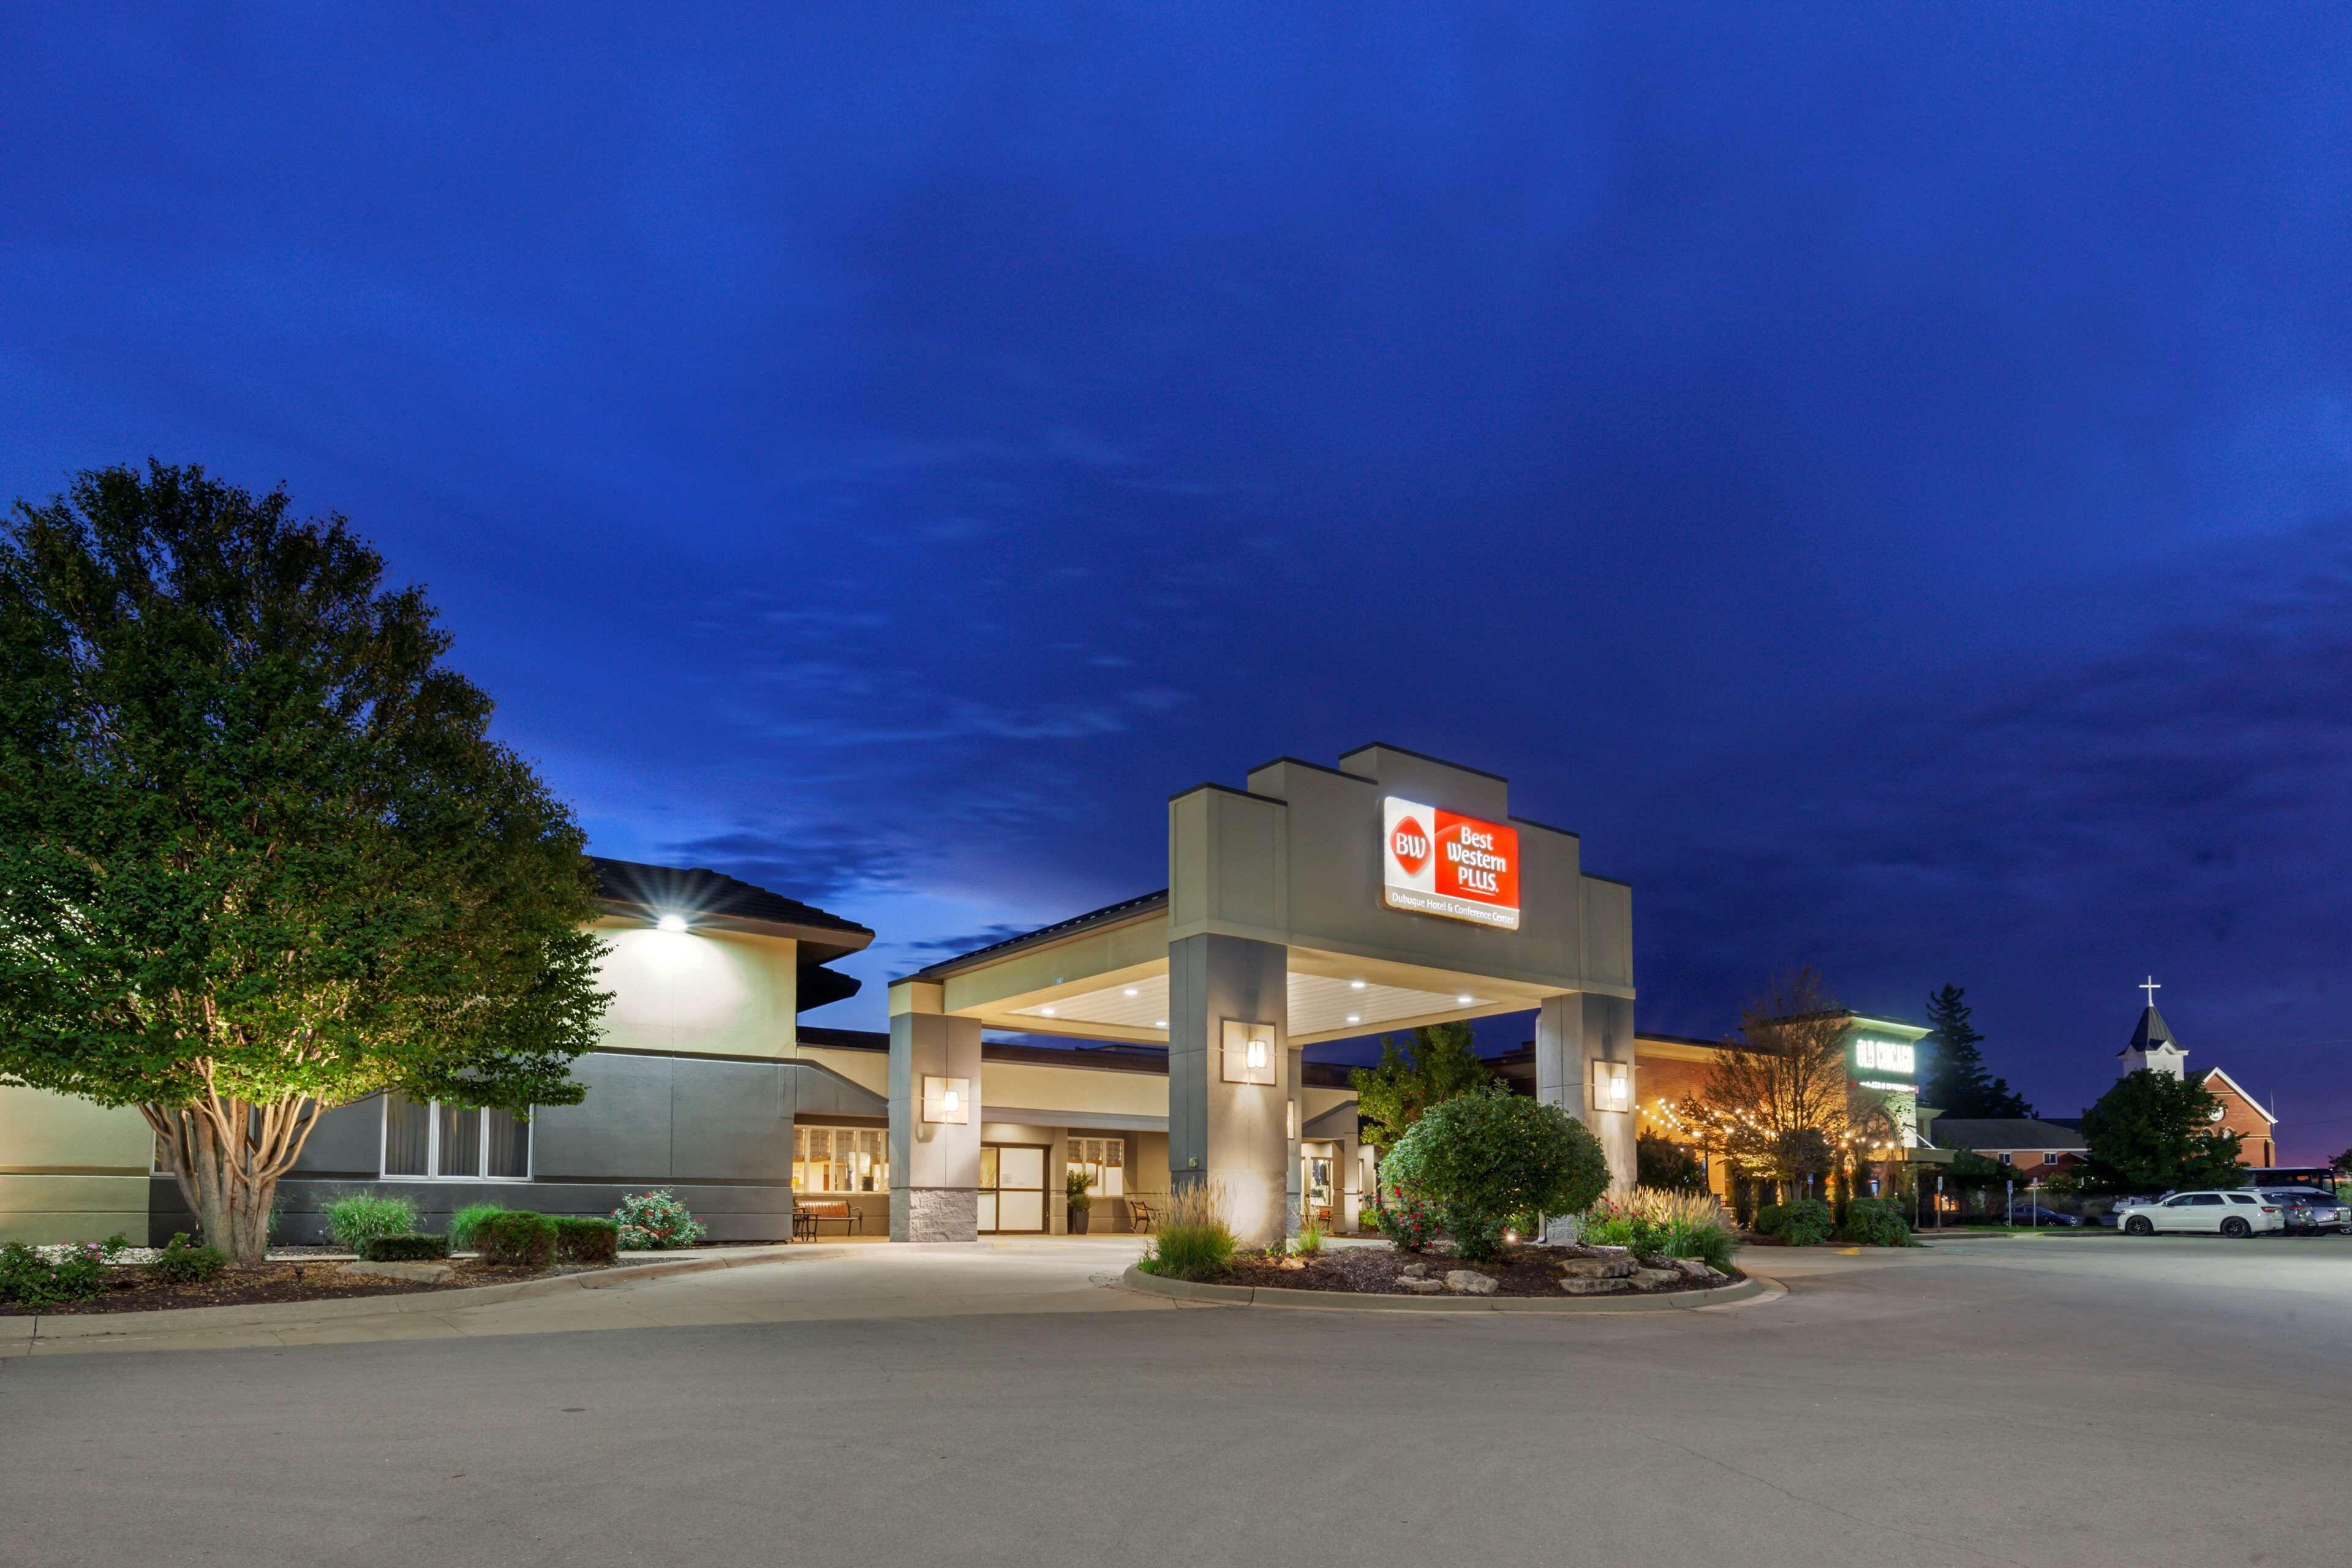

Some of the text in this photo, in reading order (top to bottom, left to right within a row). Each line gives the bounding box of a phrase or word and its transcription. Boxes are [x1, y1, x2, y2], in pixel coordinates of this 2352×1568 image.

[1396, 832, 1426, 859] BW
[1461, 826, 1494, 851] Best
[1447, 842, 1507, 873] Western
[1392, 892, 1515, 924] Dubuque Hotel & Conference Center
